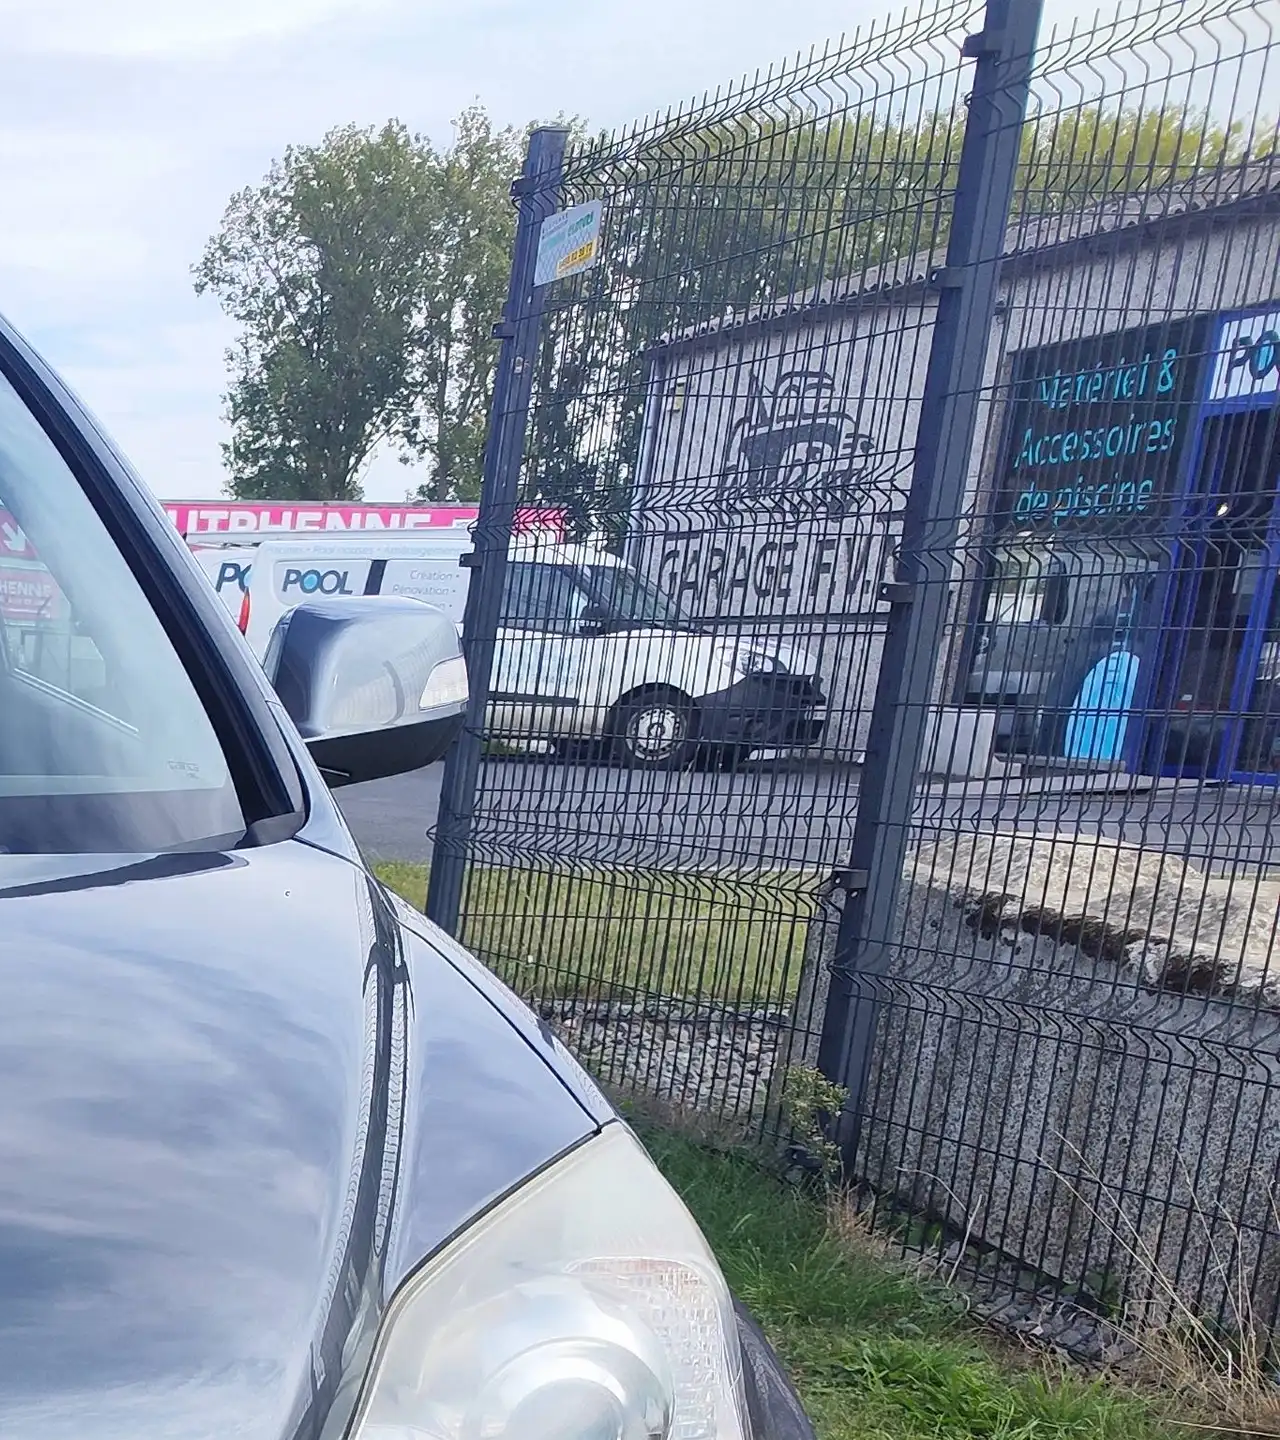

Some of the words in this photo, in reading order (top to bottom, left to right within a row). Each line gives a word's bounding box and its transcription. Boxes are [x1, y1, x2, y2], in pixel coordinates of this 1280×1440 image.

[1040, 353, 1151, 409] Matériel
[1156, 348, 1178, 393] &
[1014, 413, 1178, 469] Accessoires
[1015, 481, 1049, 521] de
[1051, 472, 1154, 528] piscine
[282, 567, 354, 596] POOL
[659, 540, 799, 601] GARAGE
